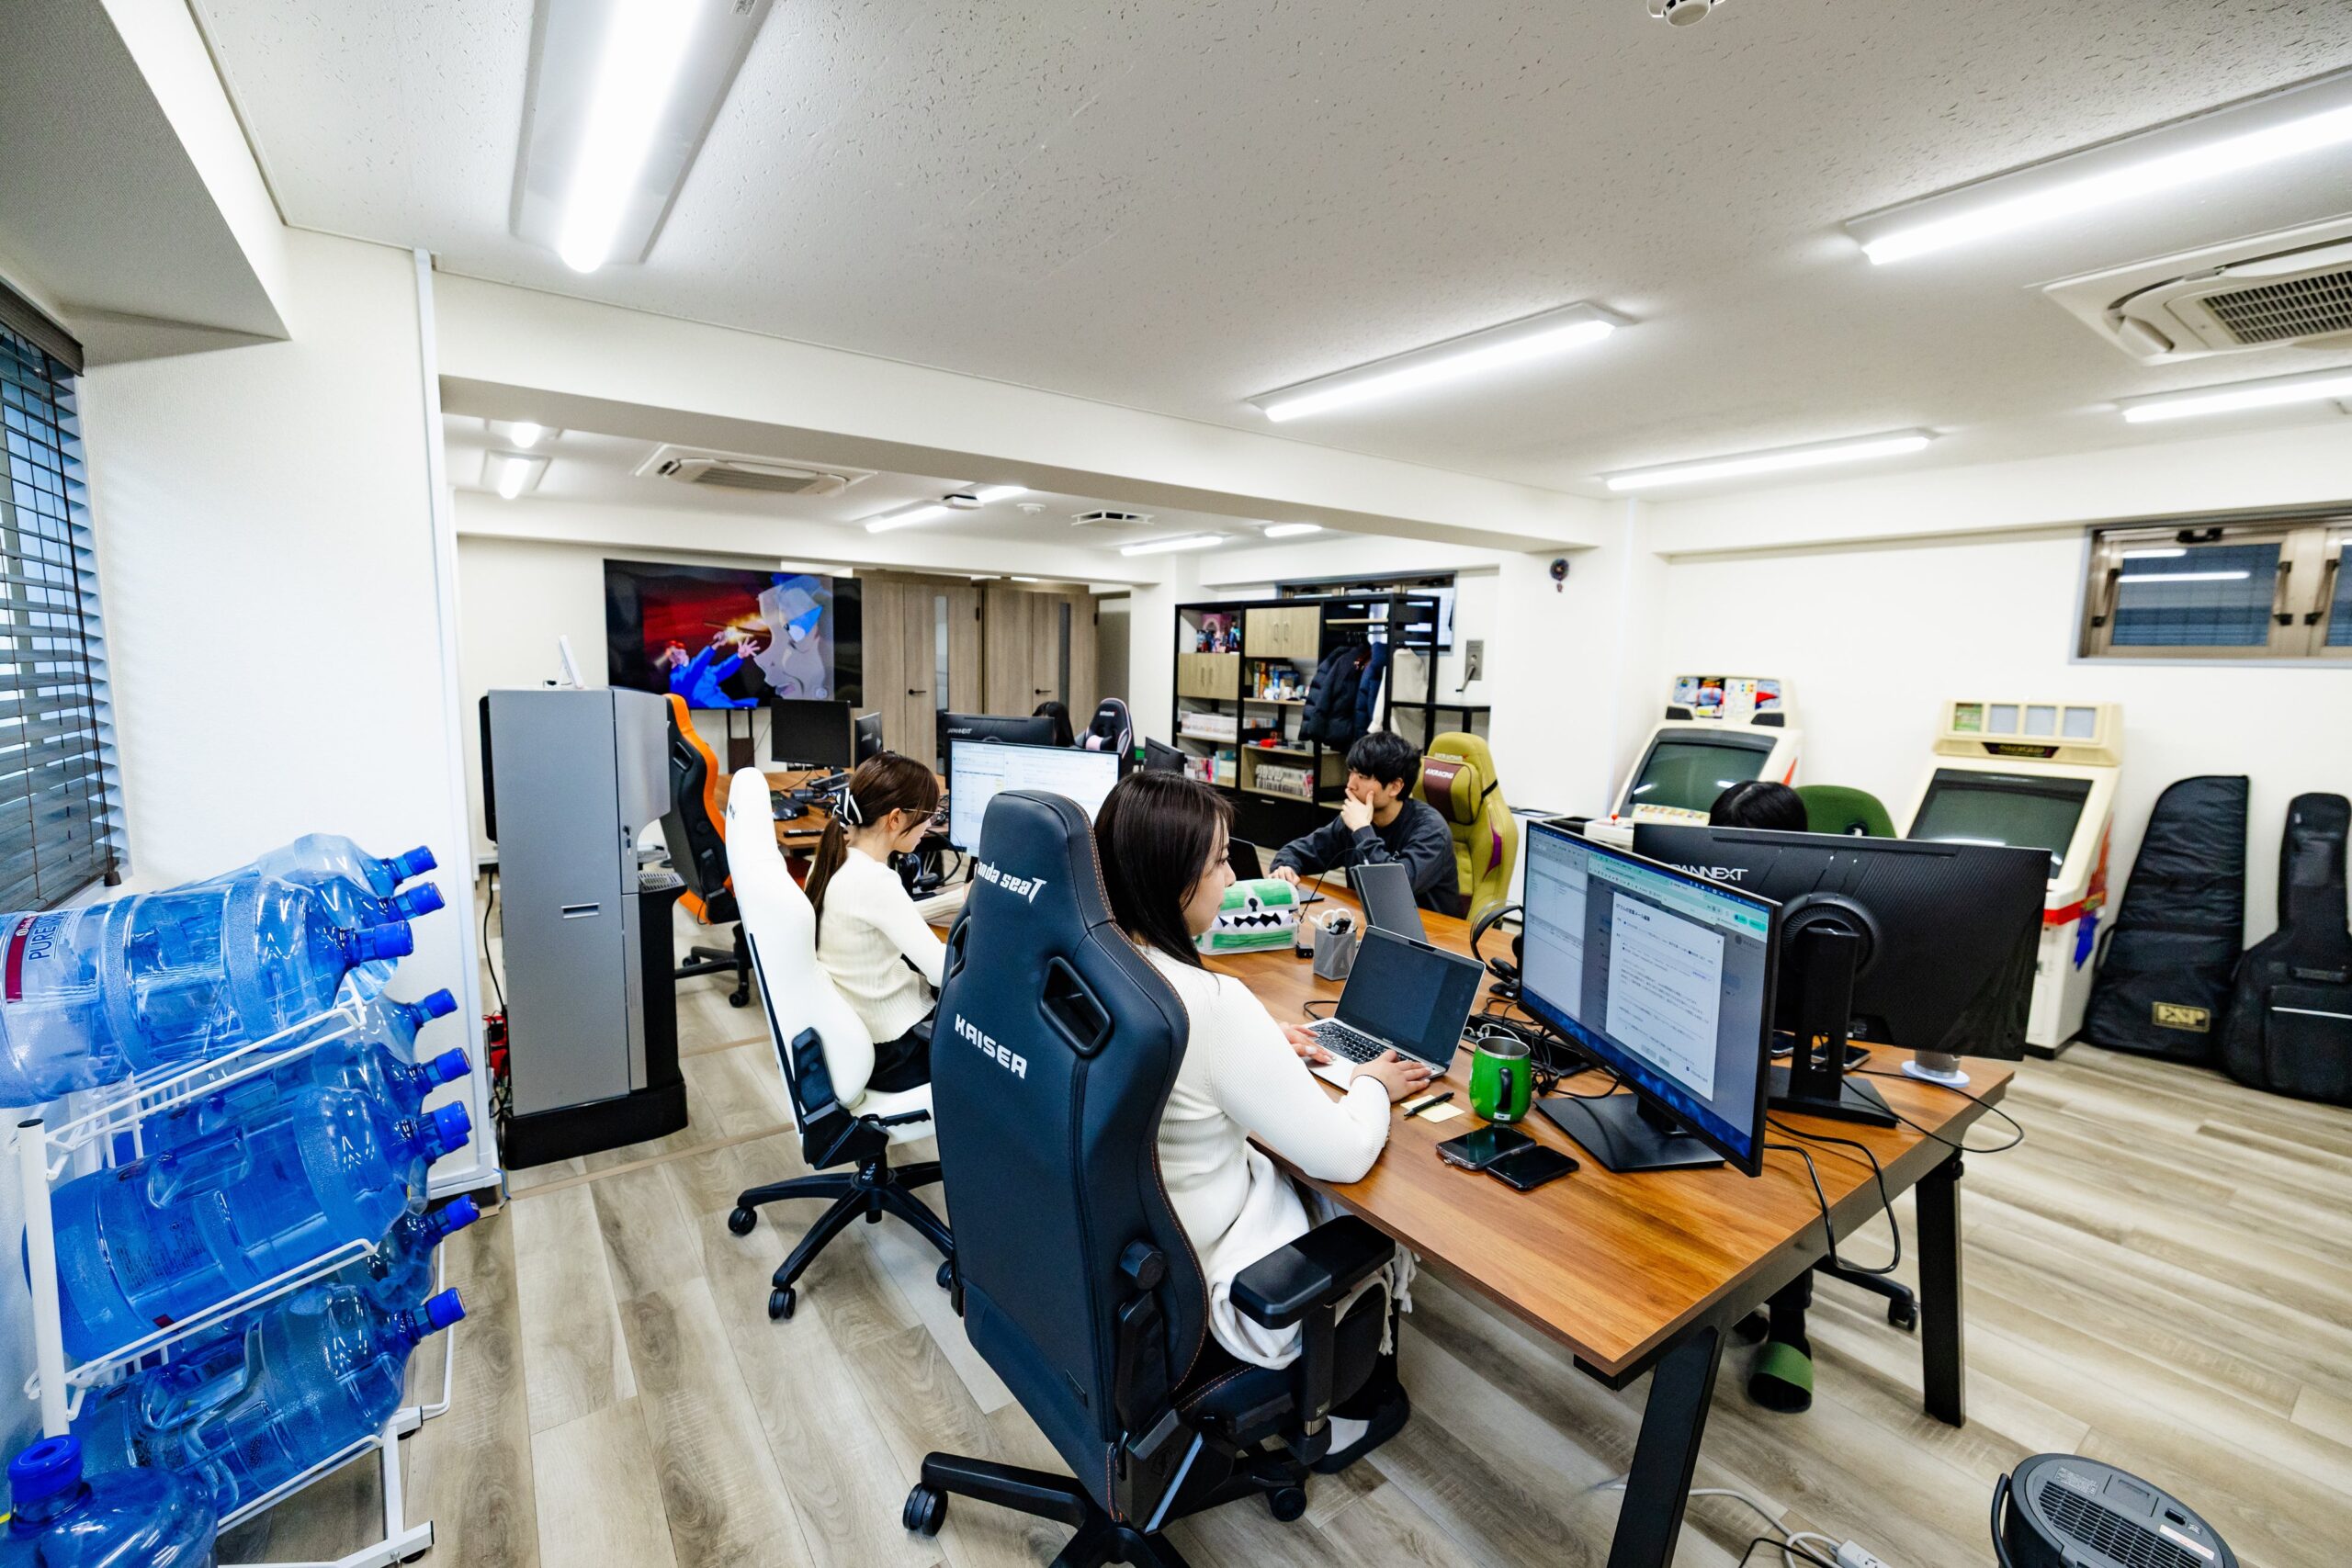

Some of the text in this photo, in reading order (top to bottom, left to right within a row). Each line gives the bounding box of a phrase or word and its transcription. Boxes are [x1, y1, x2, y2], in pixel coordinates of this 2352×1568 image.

[28, 926, 55, 960] PURE
[2158, 1005, 2205, 1025] ESP
[955, 1013, 1027, 1079] KAISER
